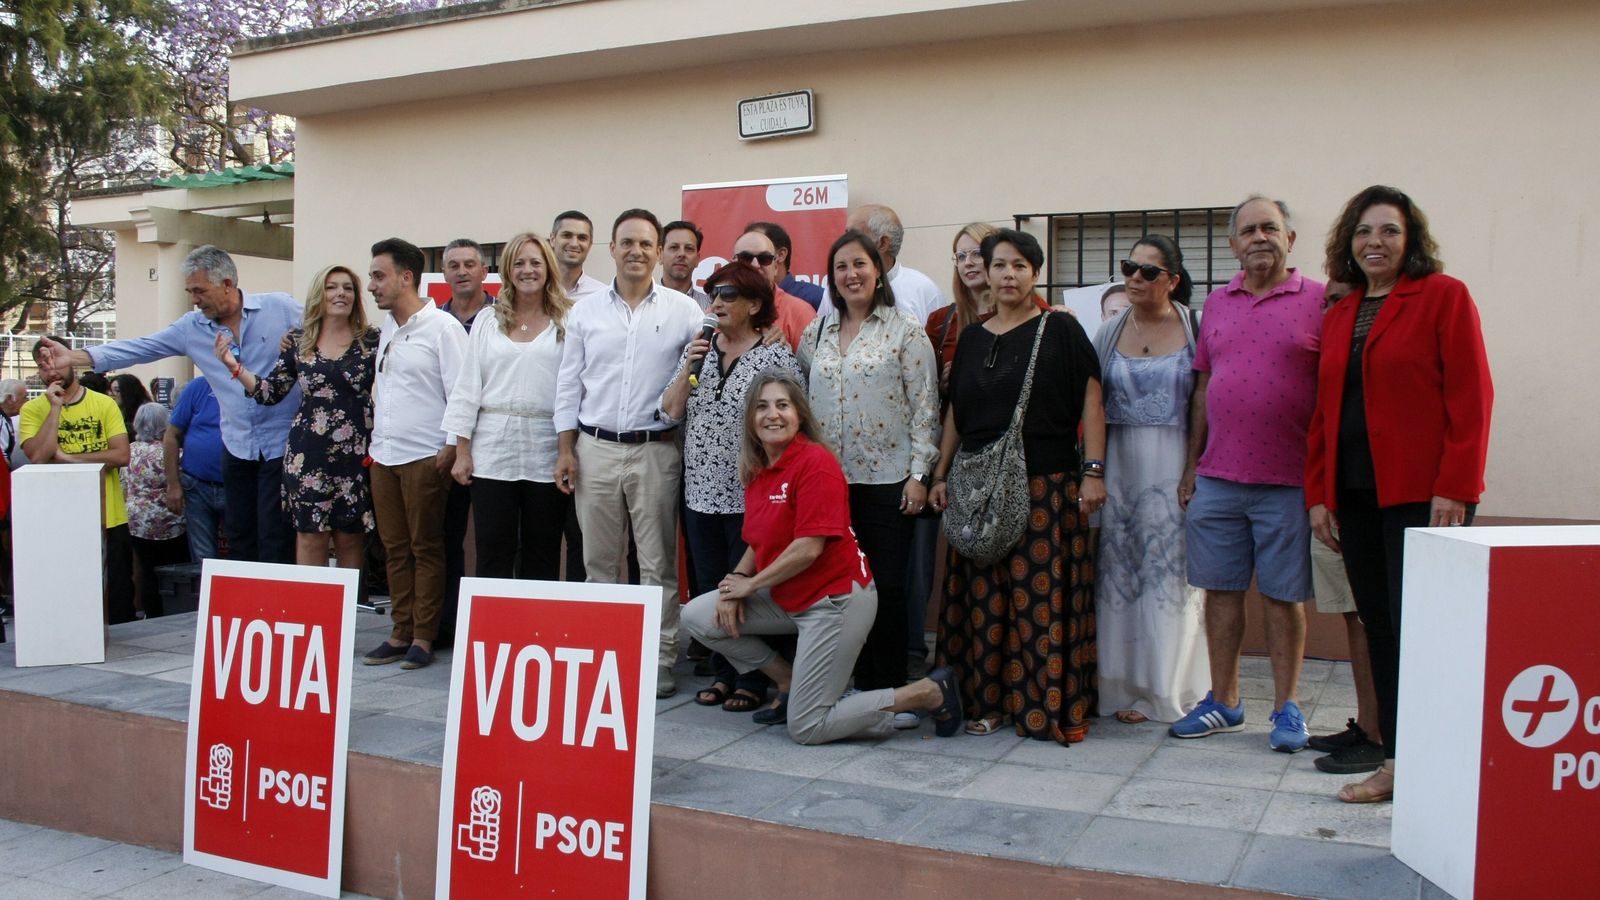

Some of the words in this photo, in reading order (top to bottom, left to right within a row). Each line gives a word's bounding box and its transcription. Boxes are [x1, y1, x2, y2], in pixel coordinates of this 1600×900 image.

[742, 103, 758, 117] ESTA
[759, 100, 778, 113] PLAZA
[780, 98, 787, 111] ES
[761, 116, 788, 131] CUIDALA
[793, 186, 828, 206] 26M
[212, 615, 331, 714] VOTA
[473, 641, 629, 751] VOTA
[258, 767, 327, 811] PSOE
[1552, 751, 1600, 791] PO
[535, 812, 625, 861] PSOE
